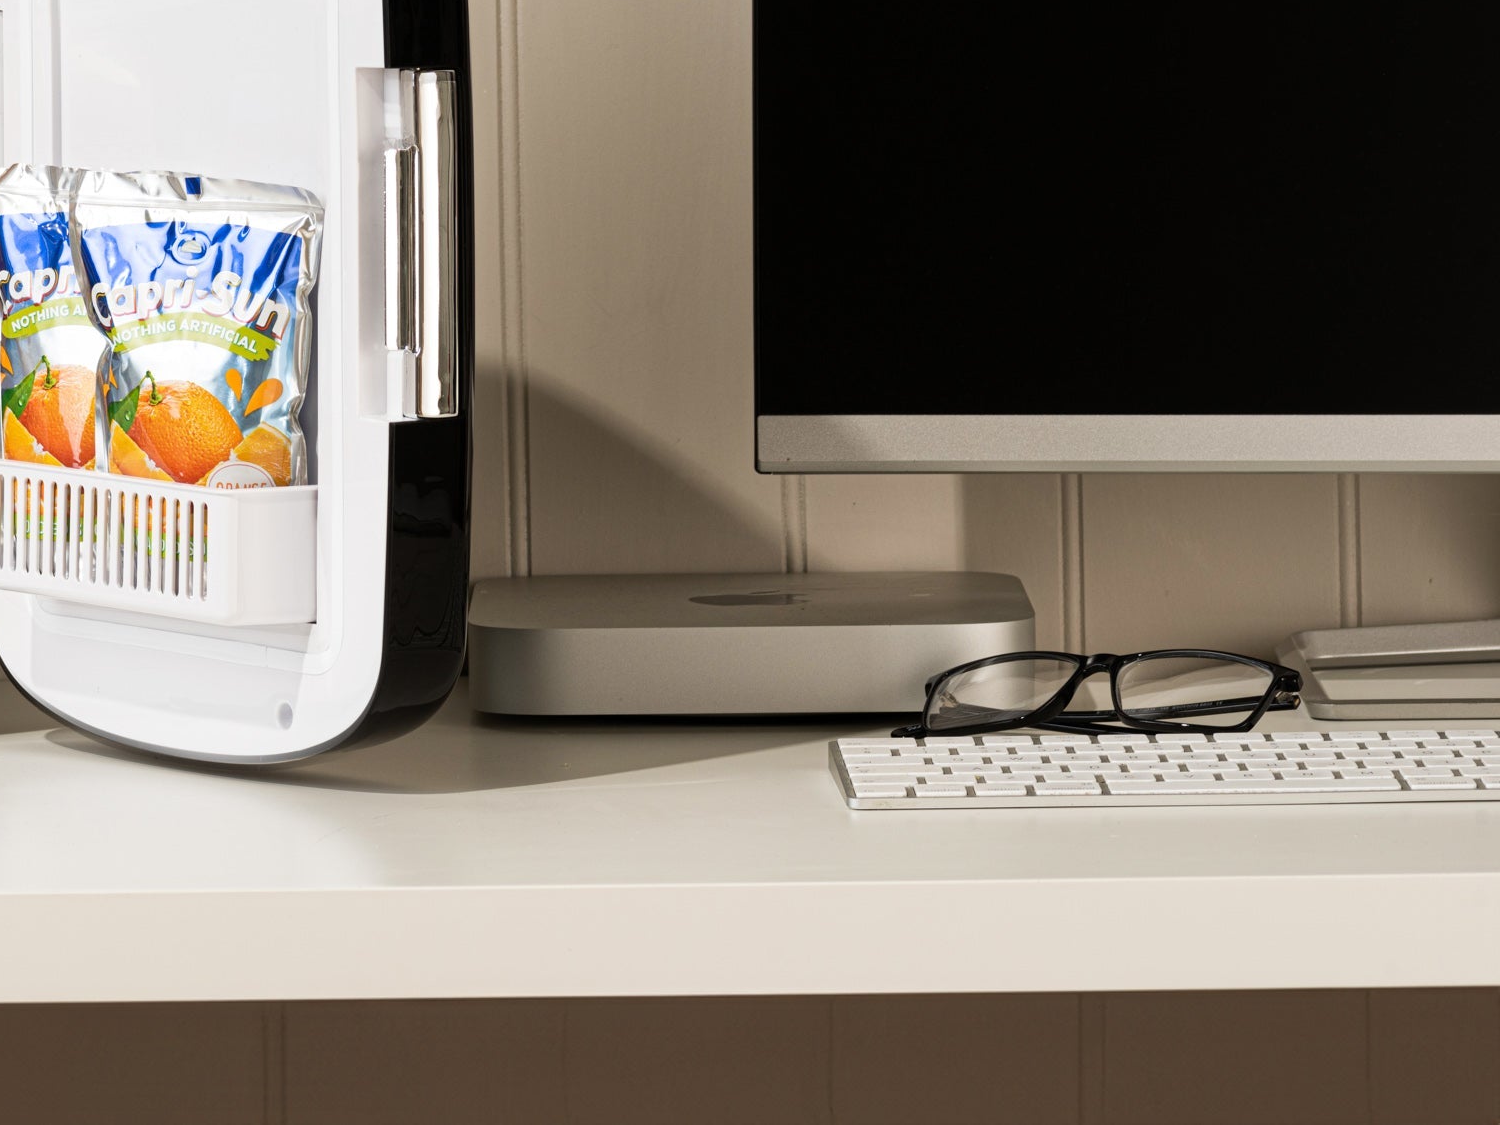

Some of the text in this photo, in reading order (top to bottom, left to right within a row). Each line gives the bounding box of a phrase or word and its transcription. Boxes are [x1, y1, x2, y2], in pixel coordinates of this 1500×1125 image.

[11, 304, 69, 333] NOTHING
[91, 265, 292, 342] Capri-Sun
[110, 318, 259, 355] NOTHING ARTIFICIAL
